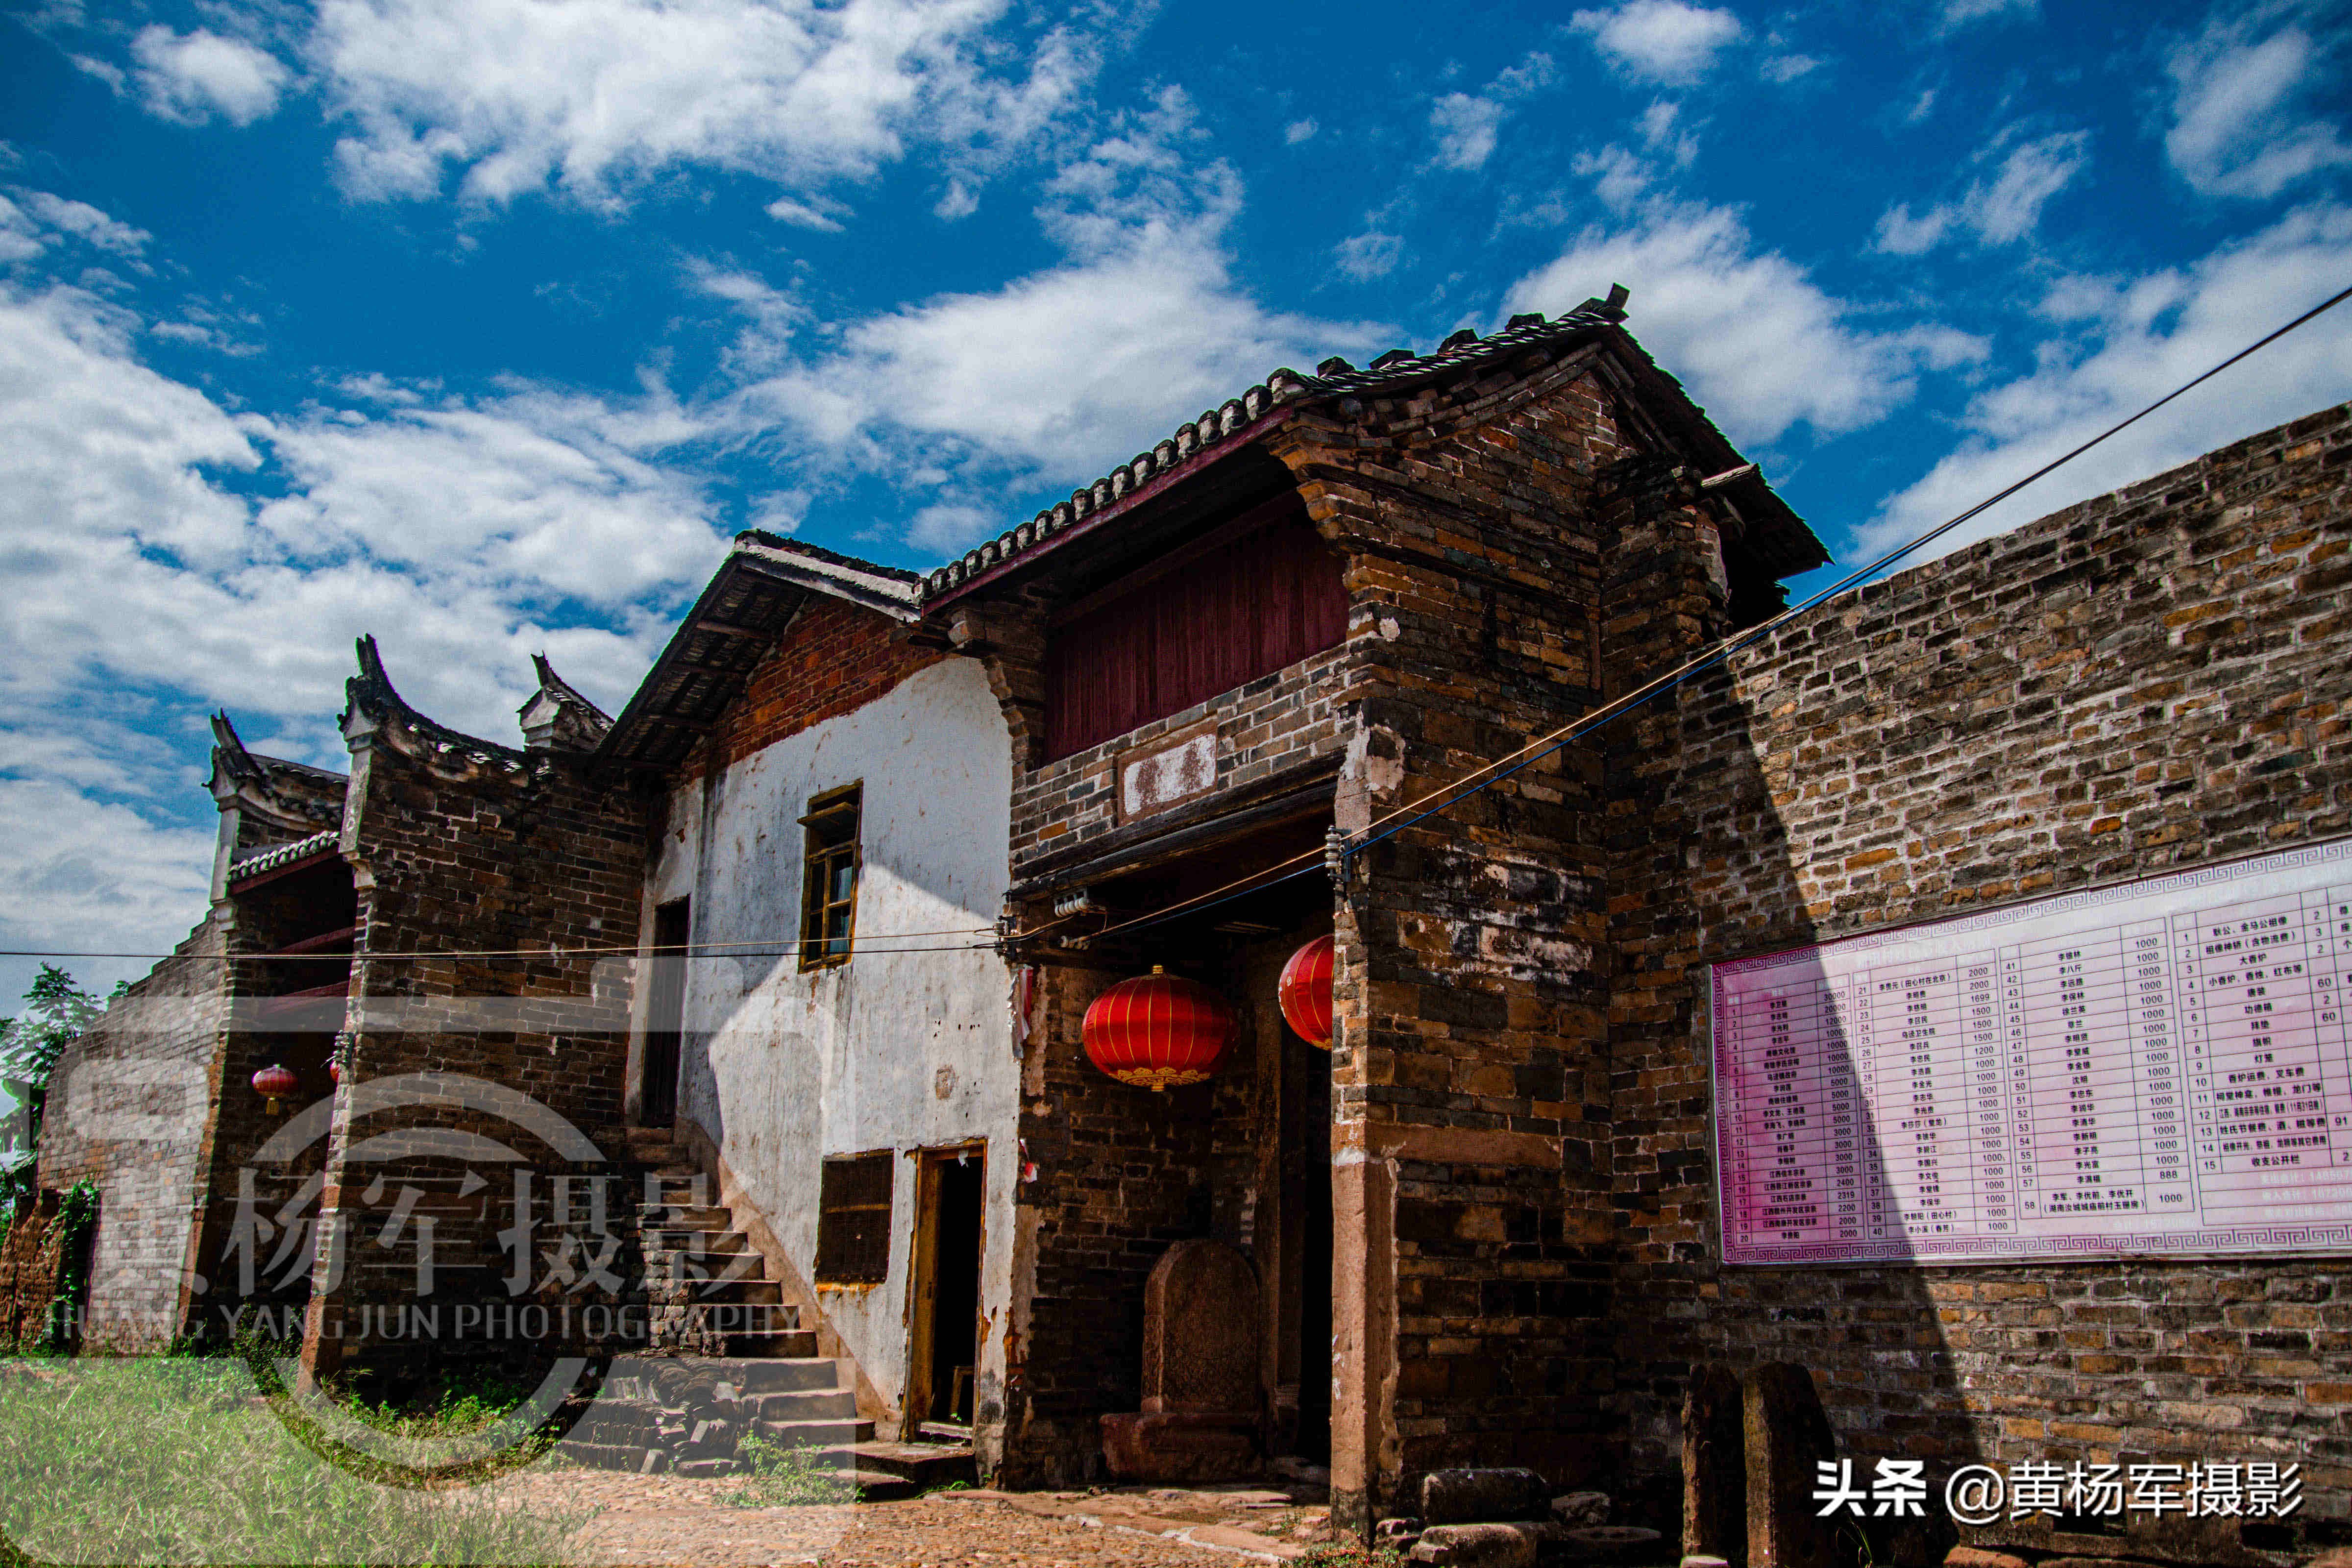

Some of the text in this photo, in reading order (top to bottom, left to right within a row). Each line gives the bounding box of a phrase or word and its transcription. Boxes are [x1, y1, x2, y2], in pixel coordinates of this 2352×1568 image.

[2314, 910, 2320, 920] 2
[2135, 938, 2157, 948] 1000
[2185, 950, 2191, 958] 2
[2316, 927, 2322, 936] 3
[2137, 952, 2158, 962] 1000
[2239, 953, 2267, 965] 大香炉
[2317, 945, 2324, 954] 2
[1969, 967, 1987, 977] 2000
[2138, 966, 2160, 977] 1000
[1970, 980, 1989, 990] 2000
[2139, 980, 2161, 991] 1000
[1824, 992, 1844, 1001] 30000
[2190, 997, 2196, 1005] 5
[2317, 978, 2331, 988] 60
[1971, 993, 1989, 1002] 1699
[2140, 995, 2163, 1004] 1000
[2324, 995, 2330, 1004] 2
[1825, 1004, 1845, 1014] 20000
[1972, 1006, 1990, 1015] 1500
[2142, 1009, 2164, 1019] 1000
[1825, 1016, 1846, 1026] 12000
[2322, 1012, 2335, 1022] 60
[1973, 1019, 1991, 1029] 1500
[1827, 1029, 1846, 1037] 10000
[1974, 1032, 1992, 1042] 1500
[2012, 1041, 2022, 1050] 47
[2143, 1023, 2166, 1033] 1000
[1827, 1040, 1847, 1049] 10000
[2145, 1038, 2167, 1048] 1000
[1975, 1046, 1993, 1054] 1200
[2195, 1045, 2201, 1054] 8
[1827, 1052, 1849, 1062] 10000
[2146, 1053, 2168, 1062] 1000
[1976, 1059, 1994, 1068] 1000
[1828, 1065, 1849, 1075] 10000
[1831, 1078, 1848, 1086] 5000
[1977, 1073, 1995, 1081] 1000
[2015, 1082, 2026, 1091] 50
[2148, 1066, 2170, 1077] 1000
[2149, 1081, 2171, 1091] 1000
[2196, 1078, 2206, 1087] 10
[1832, 1090, 1848, 1099] 5000
[1978, 1086, 1997, 1095] 1000
[1832, 1102, 1849, 1111] 5000
[1979, 1099, 1998, 1107] 1000
[2017, 1110, 2028, 1118] 52
[2151, 1096, 2173, 1105] 1000
[1833, 1115, 1850, 1124] 5000
[1980, 1112, 1999, 1121] 1000
[2152, 1110, 2174, 1120] 1000
[1981, 1126, 2001, 1135] 1000
[2153, 1125, 2176, 1135] 1000
[2201, 1127, 2212, 1136] 13
[2335, 1116, 2347, 1126] 91
[1834, 1127, 1851, 1137] 3000
[1835, 1140, 1852, 1150] 3000
[1982, 1140, 2001, 1148] 1000
[2155, 1141, 2177, 1150] 1000
[1835, 1152, 1853, 1162] 3000
[1869, 1162, 1878, 1171] 35
[1984, 1153, 2002, 1162] 1000
[2156, 1155, 2179, 1164] 1000
[2204, 1152, 2350, 1170] 15 收支公开栏 2
[1836, 1165, 1853, 1175] 3000
[1984, 1167, 2003, 1176] 1000
[1836, 1177, 1854, 1187] 2400
[2023, 1170, 2178, 1187] 57 888
[1985, 1181, 2004, 1189] 1000
[1838, 1190, 1855, 1200] 2319
[1986, 1195, 2006, 1203] 1000
[2159, 1193, 2183, 1202] 1000
[1987, 1208, 2006, 1217] 1000
[1839, 1228, 1857, 1238] 2000
[1873, 1226, 1882, 1235] 40
